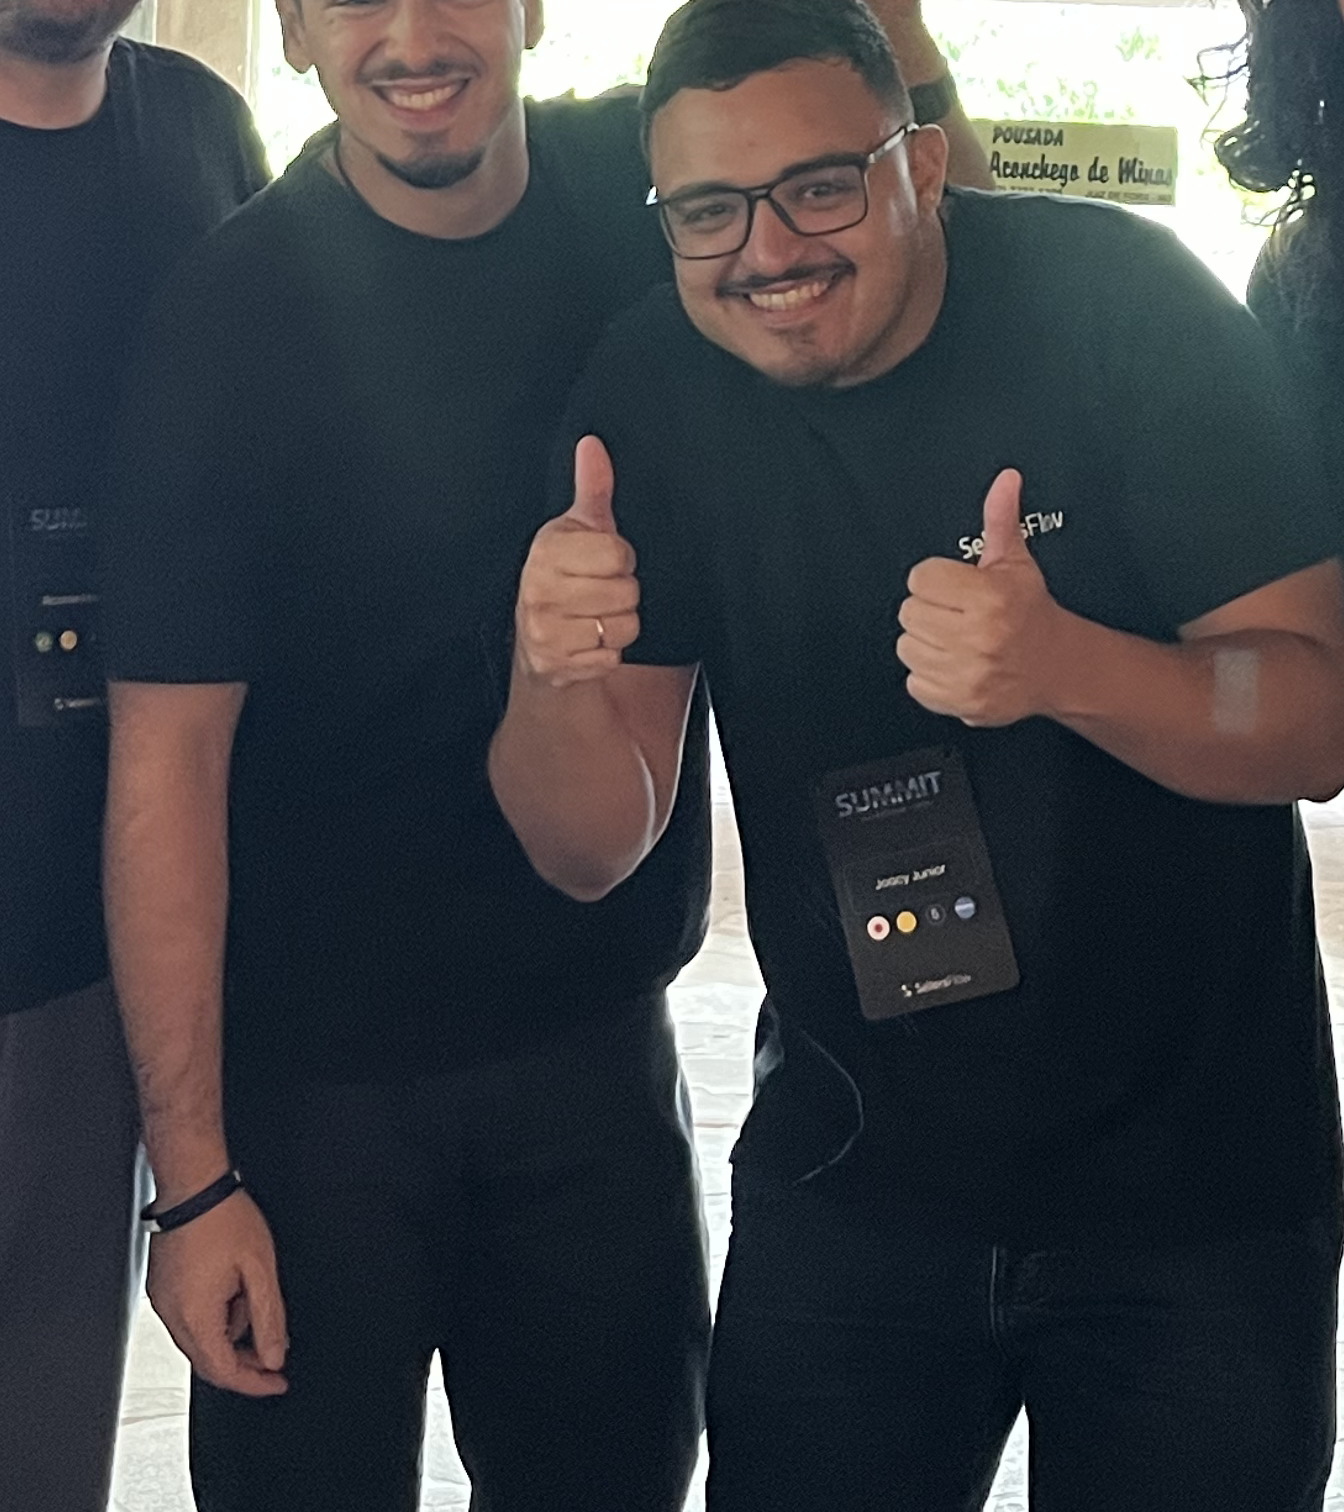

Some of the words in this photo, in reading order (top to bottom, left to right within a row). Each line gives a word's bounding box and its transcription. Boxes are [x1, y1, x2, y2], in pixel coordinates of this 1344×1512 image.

[993, 125, 1064, 147] POUSADA
[990, 151, 1080, 187] Aconchego
[1088, 156, 1109, 183] de
[1119, 156, 1174, 186] Minas
[835, 771, 942, 818] SUMMIT
